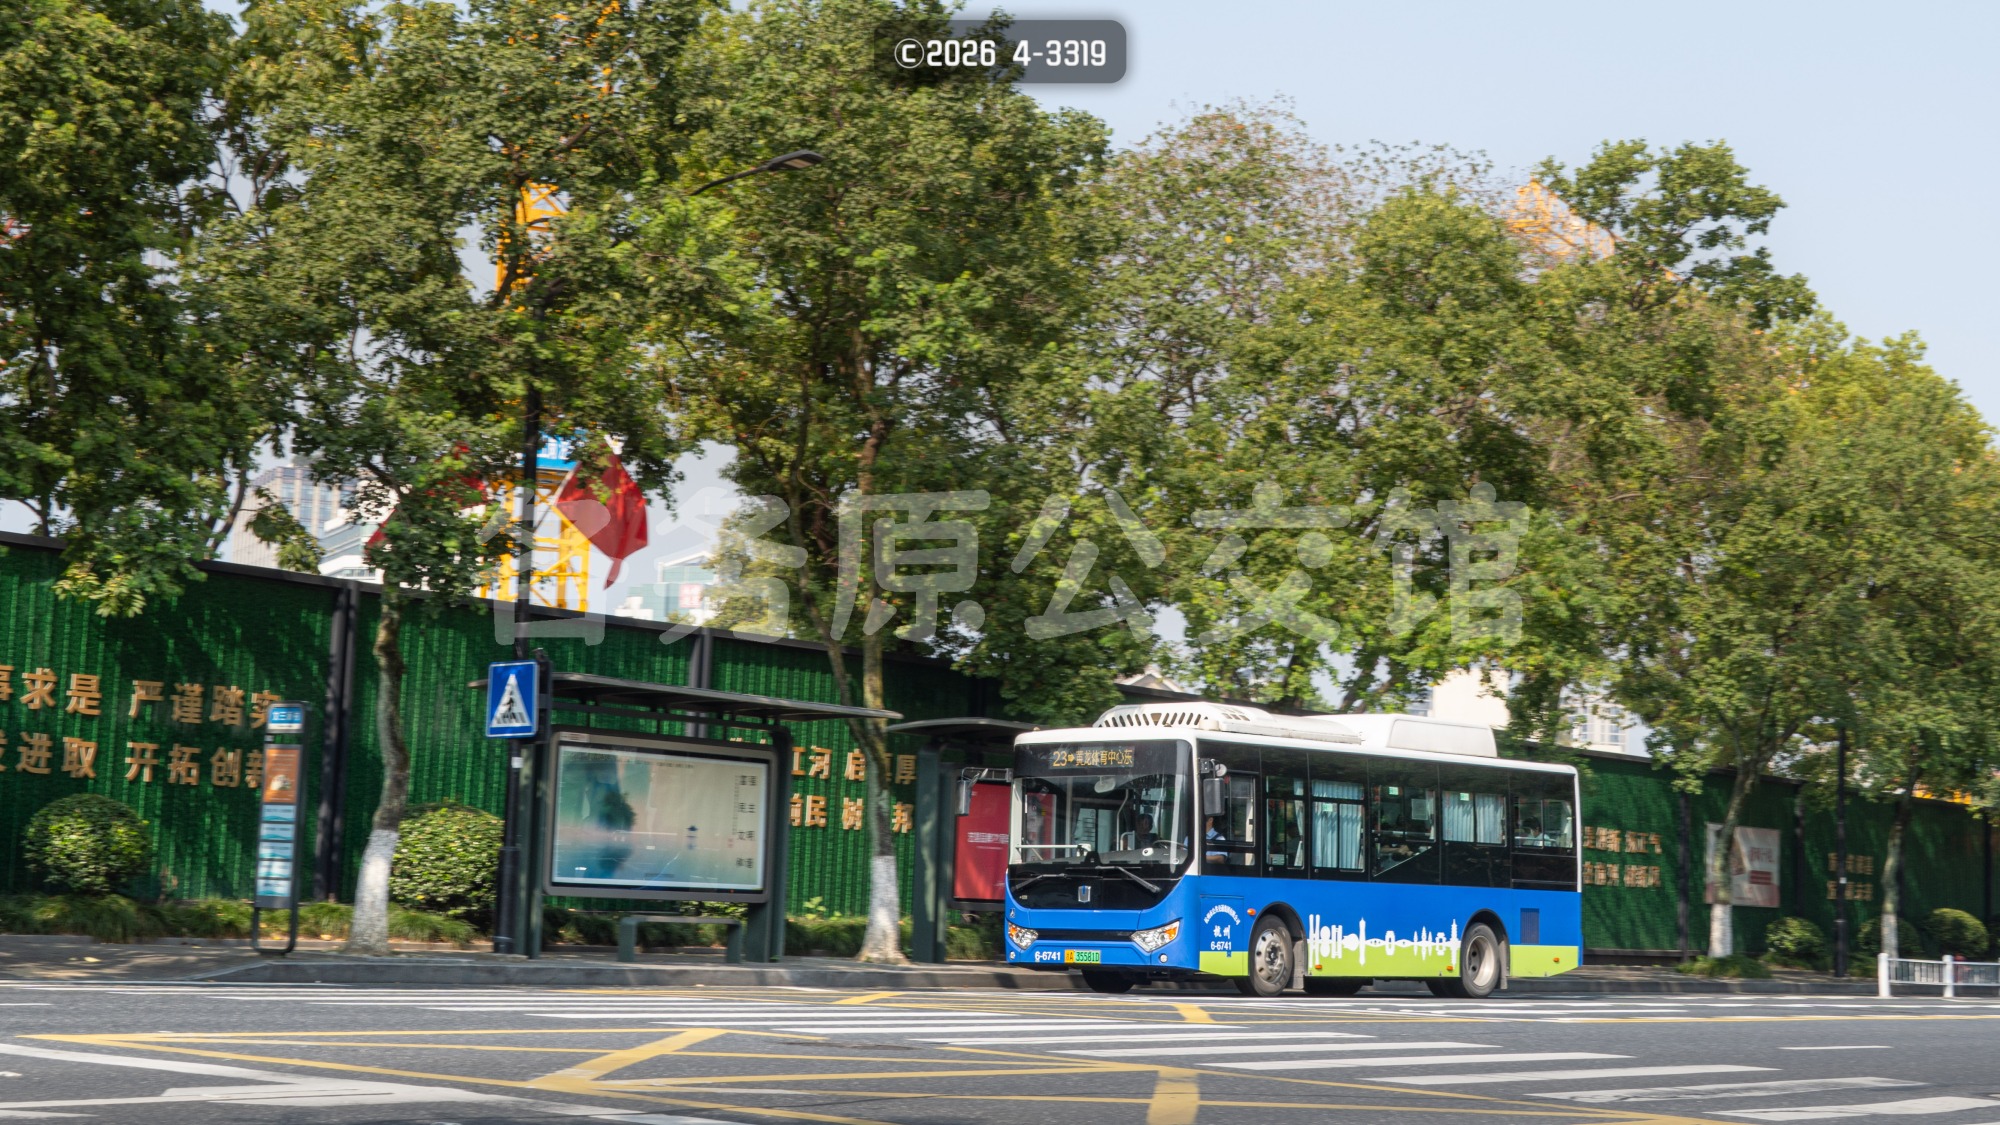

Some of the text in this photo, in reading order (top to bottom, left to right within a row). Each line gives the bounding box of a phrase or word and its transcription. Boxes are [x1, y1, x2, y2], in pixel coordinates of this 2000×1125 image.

[0, 730, 98, 778] 进取
[1052, 749, 1133, 766] 23 黄龙体育中心东
[1211, 941, 1231, 950] 6-6741
[1035, 951, 1060, 961] 6-6741
